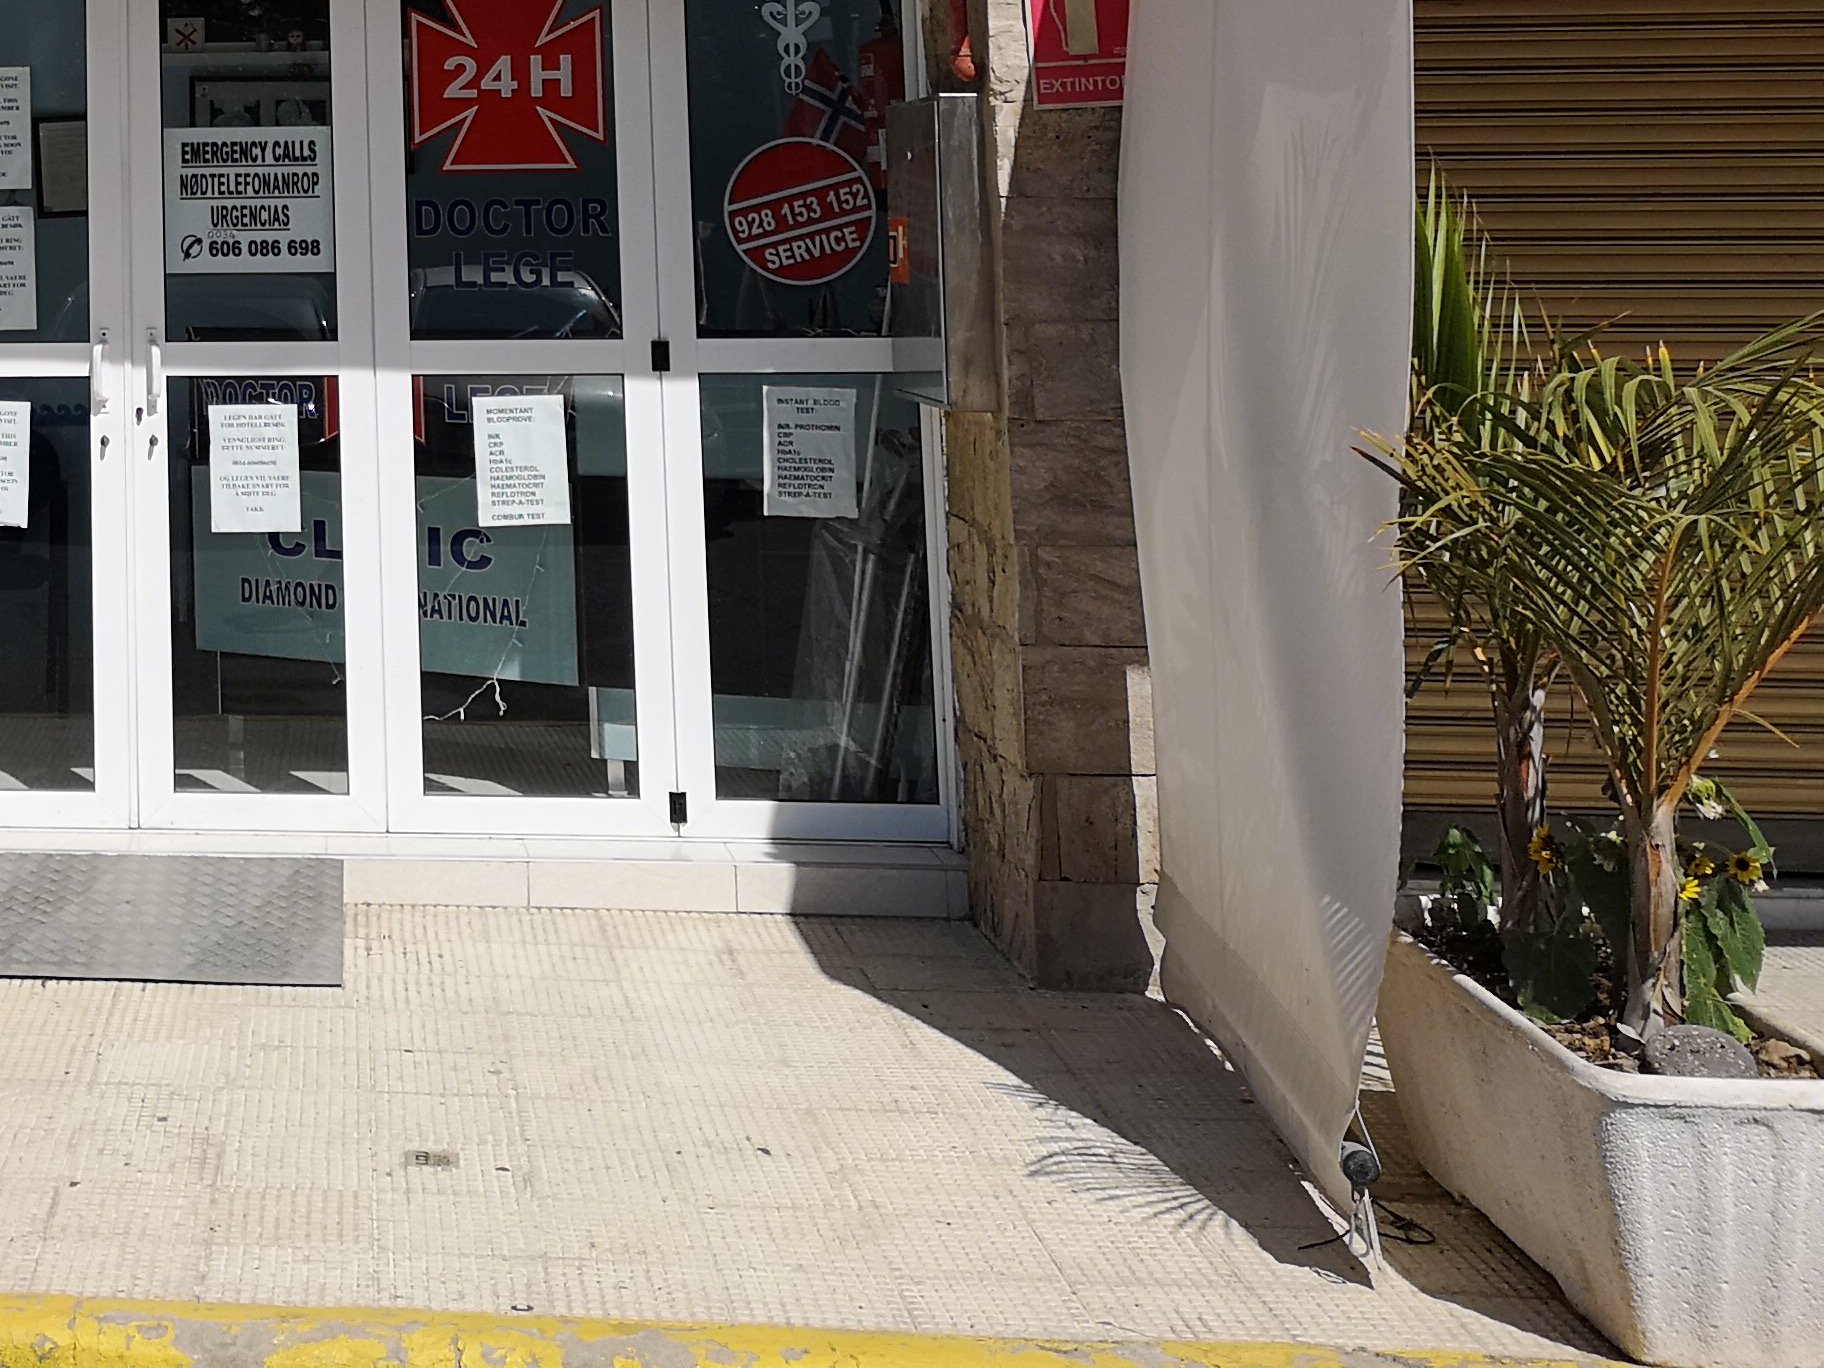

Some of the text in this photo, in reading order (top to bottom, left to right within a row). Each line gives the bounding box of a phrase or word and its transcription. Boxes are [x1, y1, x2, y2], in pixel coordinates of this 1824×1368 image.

[1039, 75, 1125, 94] EXTINTO
[181, 140, 318, 165] EMERGENCY CALLS
[179, 172, 320, 196] NØDTELEFONANROP
[210, 205, 290, 228] URGENCIAS
[414, 197, 612, 238] DOCTOR
[734, 184, 869, 239] 928 153 152
[209, 239, 321, 257] 606 086 698
[763, 226, 861, 271] SERVICE
[453, 251, 576, 291] LEGE
[240, 576, 338, 611] DIAMOND
